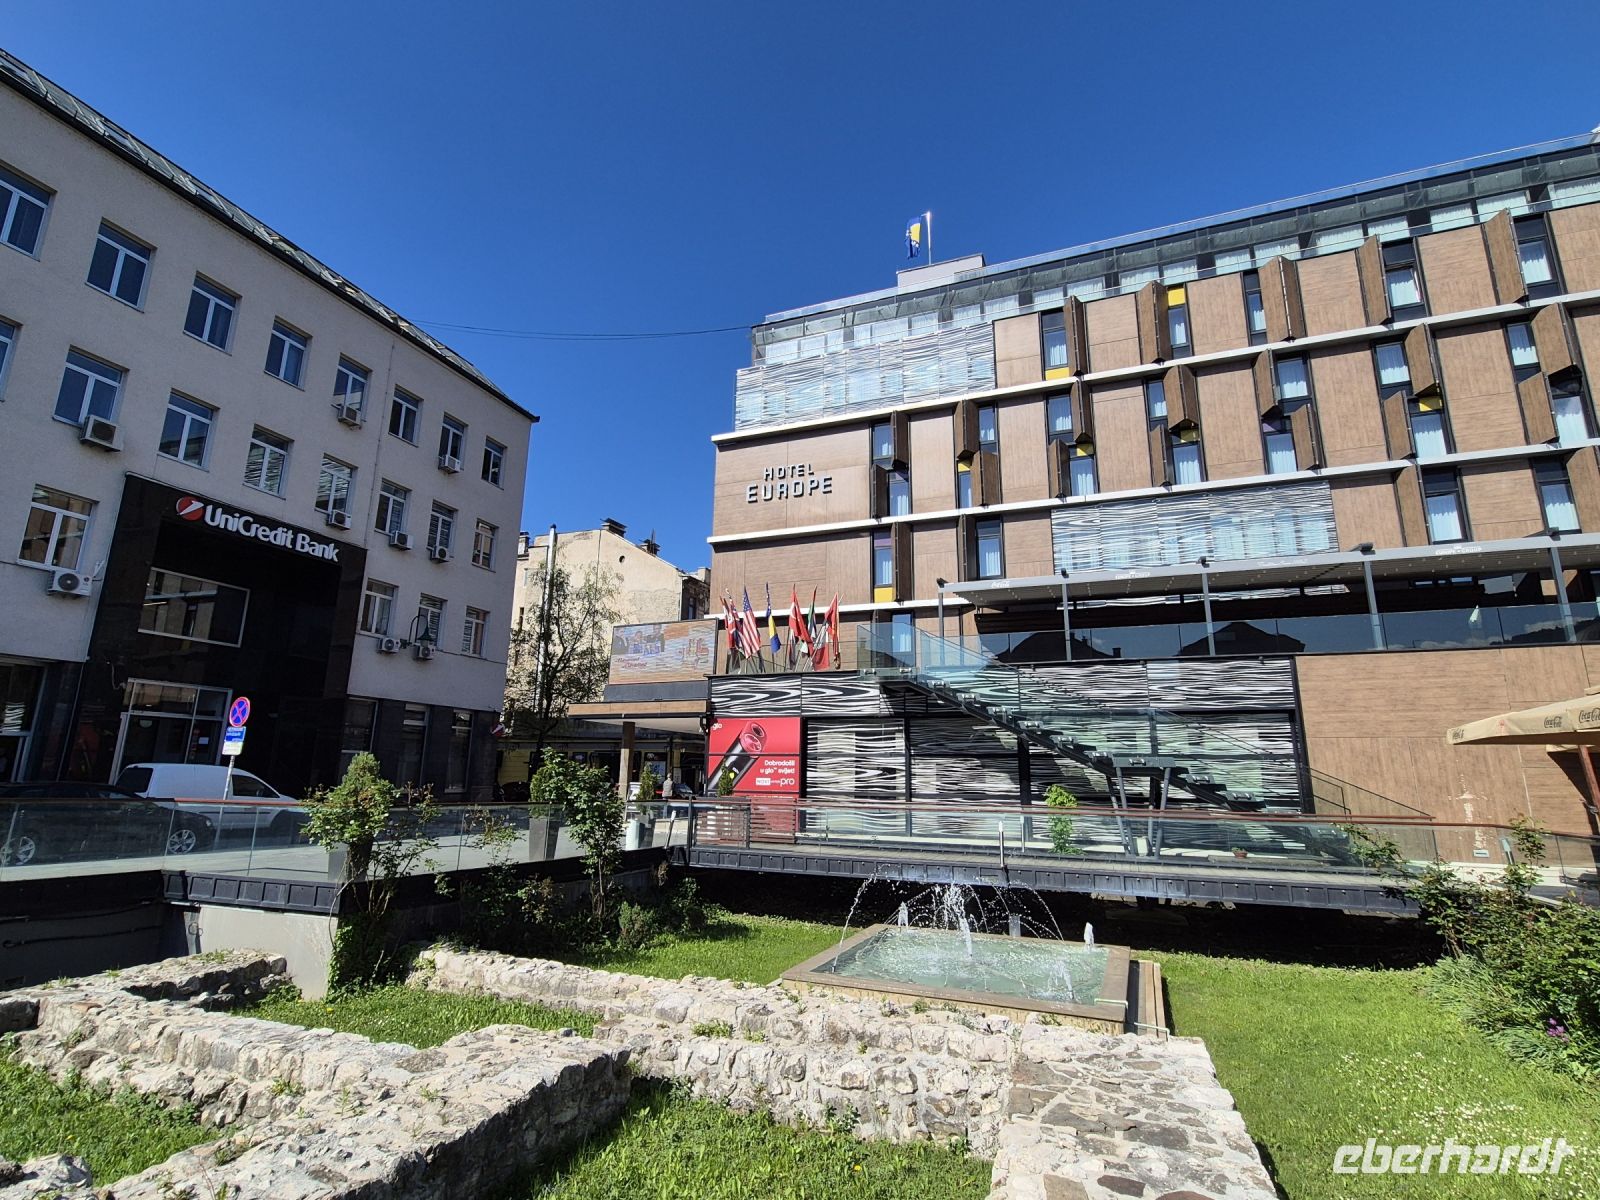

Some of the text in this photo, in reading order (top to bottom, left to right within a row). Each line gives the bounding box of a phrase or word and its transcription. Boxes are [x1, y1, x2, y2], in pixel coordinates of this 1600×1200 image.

[765, 464, 815, 481] HOTEL
[746, 476, 833, 504] EUROPE
[204, 504, 340, 562] UniCredit Bank
[780, 778, 795, 786] pro
